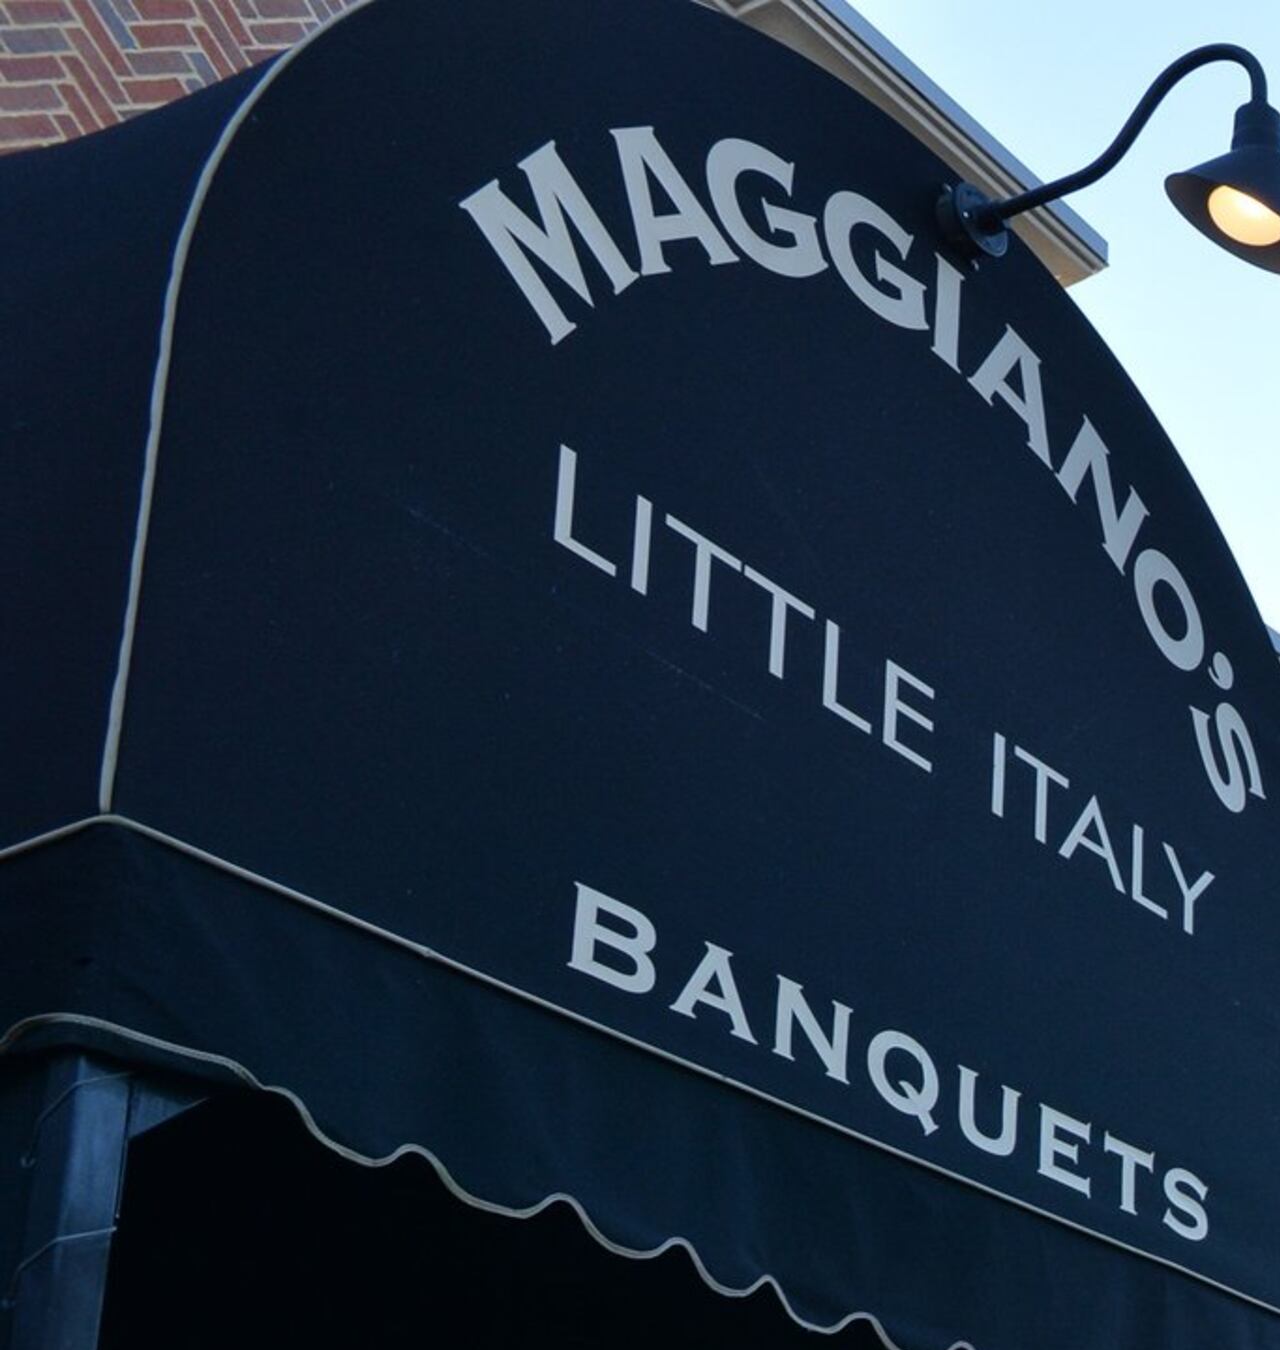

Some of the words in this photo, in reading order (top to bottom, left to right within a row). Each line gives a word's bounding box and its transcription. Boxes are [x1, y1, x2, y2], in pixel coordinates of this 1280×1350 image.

[458, 125, 1267, 814] MAGGIANO'S
[553, 443, 936, 773] LITTLE
[991, 731, 1215, 935] ITALY
[566, 880, 1211, 1242] BANQUETS
